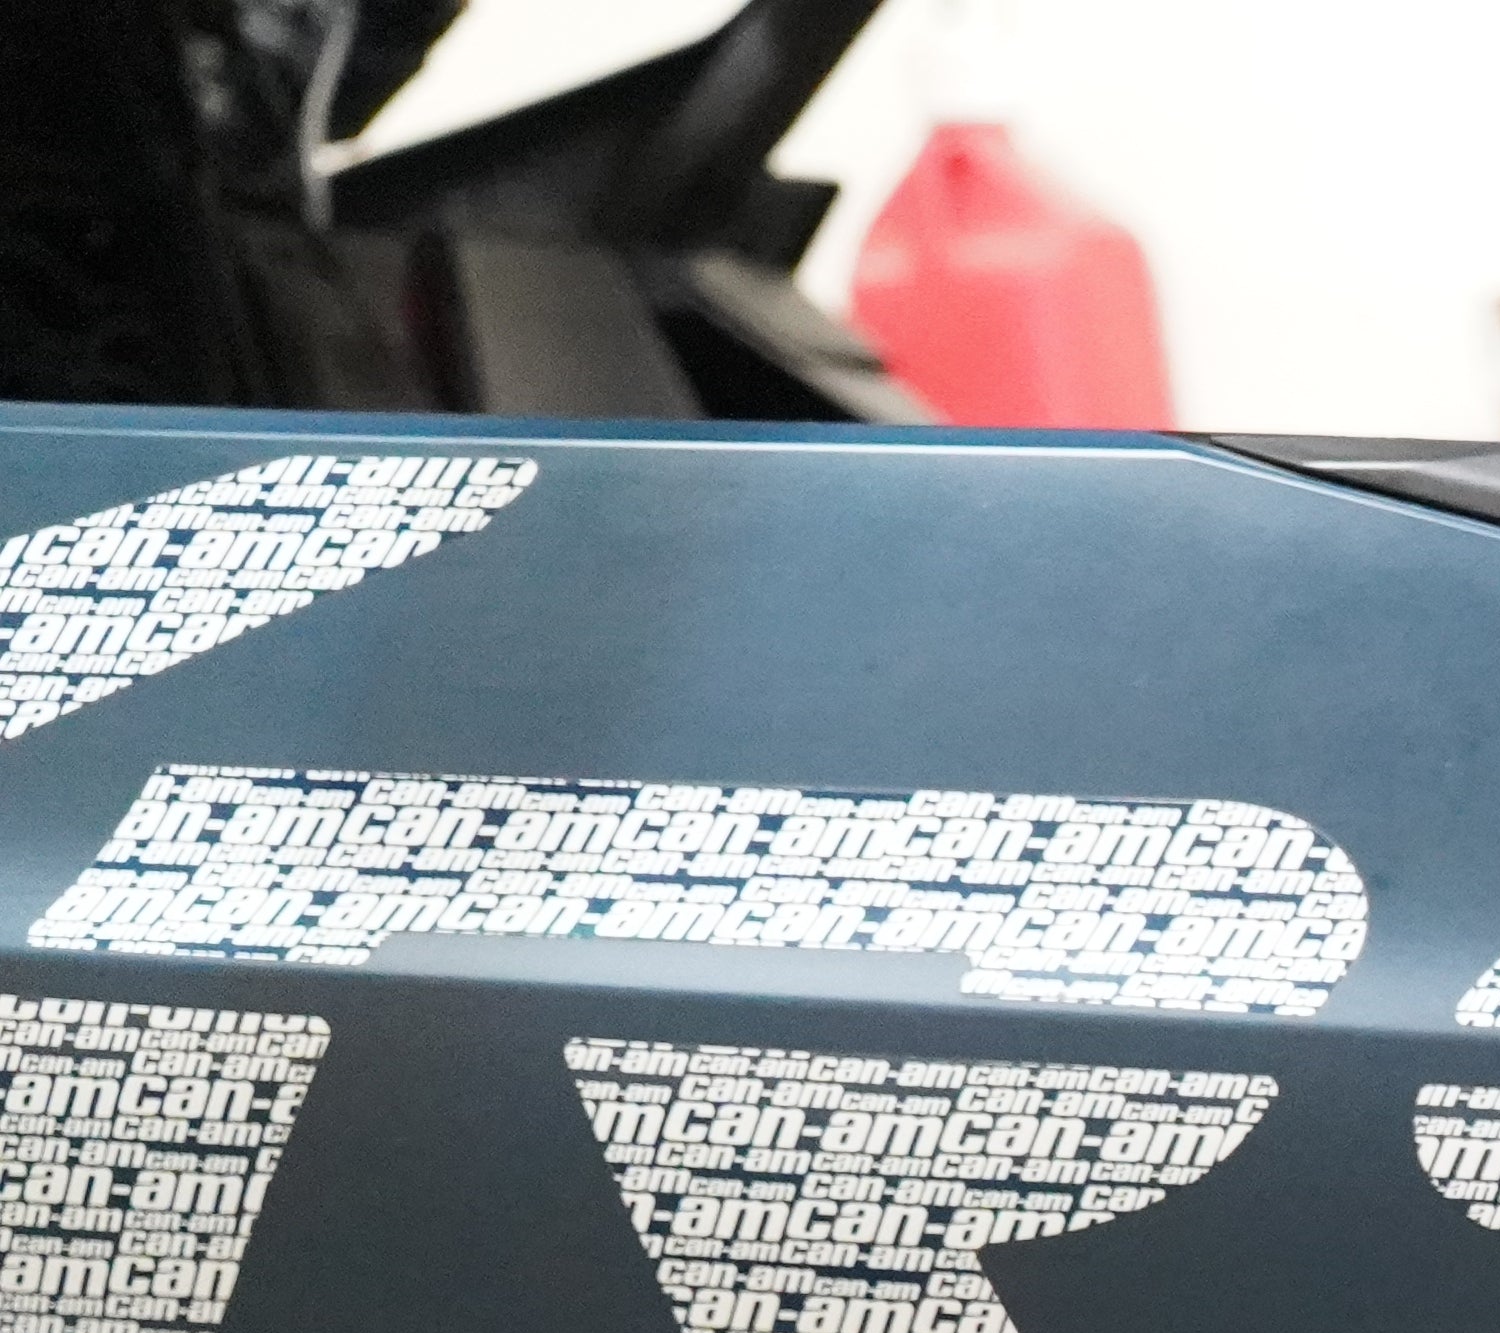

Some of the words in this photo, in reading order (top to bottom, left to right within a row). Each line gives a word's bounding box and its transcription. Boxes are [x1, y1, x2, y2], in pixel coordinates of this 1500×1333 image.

[131, 1049, 289, 1082] can-am
[809, 1058, 968, 1089] can-am
[1090, 1068, 1250, 1099] can-am
[679, 1075, 843, 1109] can-am
[956, 1086, 1125, 1119] can-am
[114, 1116, 261, 1148] can-am
[663, 1100, 942, 1156] can-am
[939, 1112, 1223, 1167] can-am
[657, 1141, 810, 1175] can-am
[932, 1154, 1089, 1185] can-am
[802, 1172, 966, 1207] can-am
[781, 1240, 934, 1273] can-am
[656, 1257, 814, 1293] can-am
